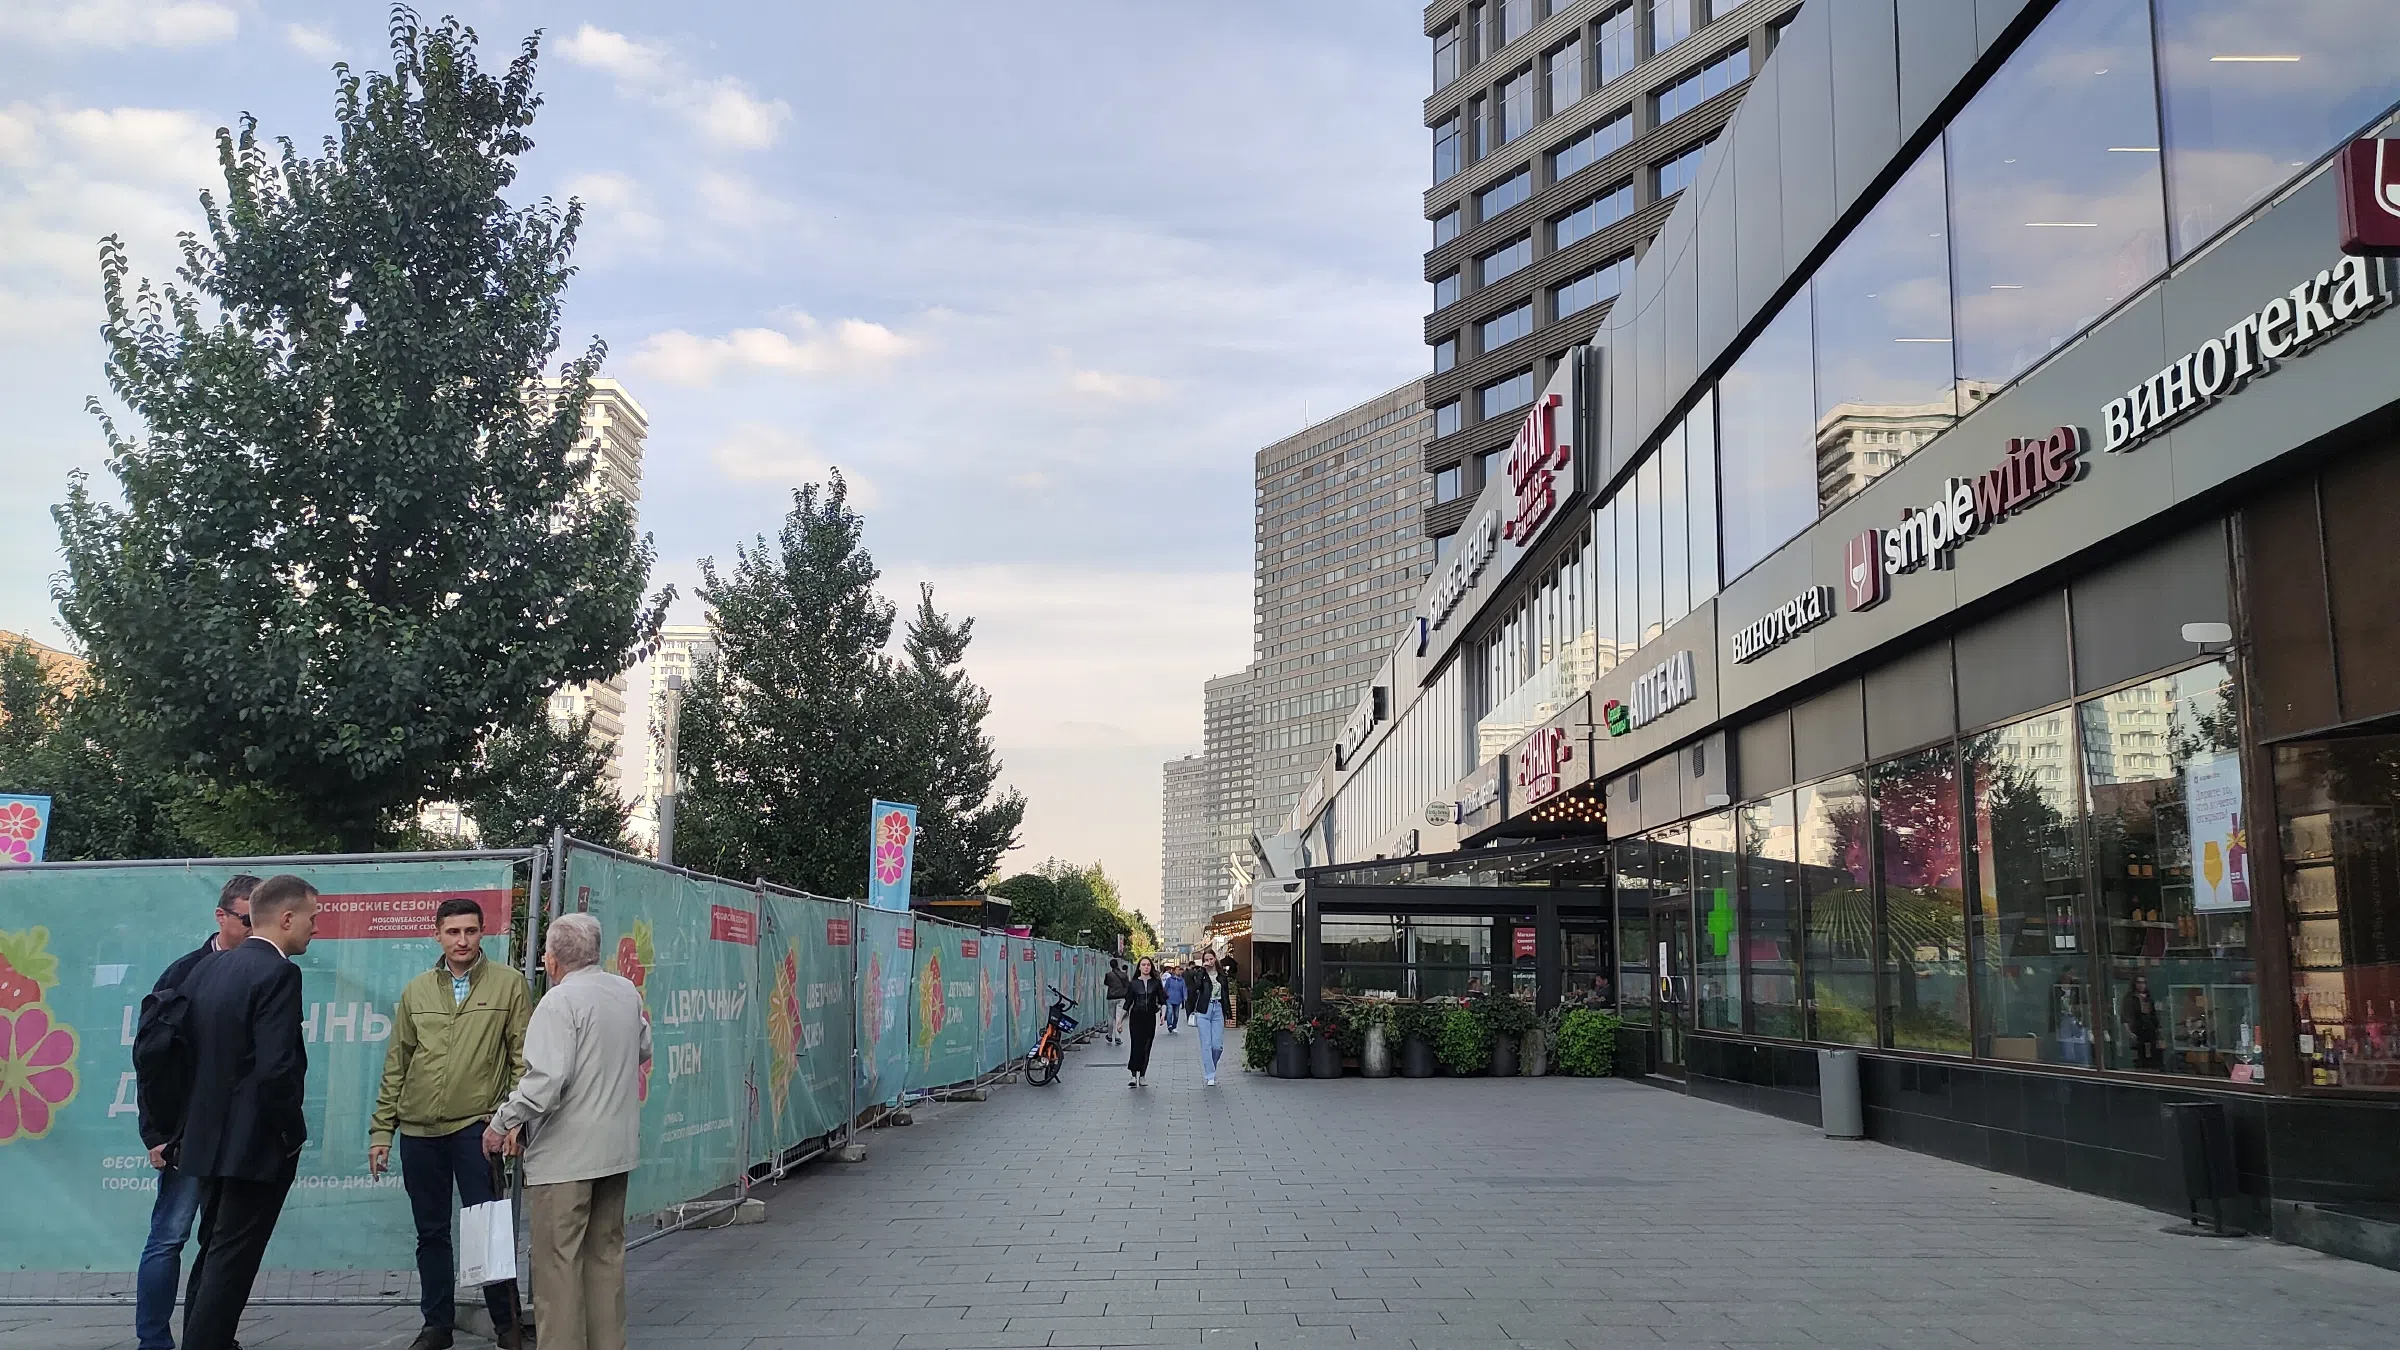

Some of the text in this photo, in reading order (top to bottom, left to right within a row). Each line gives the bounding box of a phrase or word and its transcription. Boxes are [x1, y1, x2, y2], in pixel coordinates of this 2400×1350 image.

[2101, 254, 2375, 453] винотека
[1731, 585, 1823, 664] винотека
[1630, 651, 1690, 730] АПТЕКА
[316, 902, 389, 912] ОСКОВСКИЕ
[372, 915, 437, 924] MOSCOWSEASONS.C
[102, 1156, 153, 1169] ФЕСТИ
